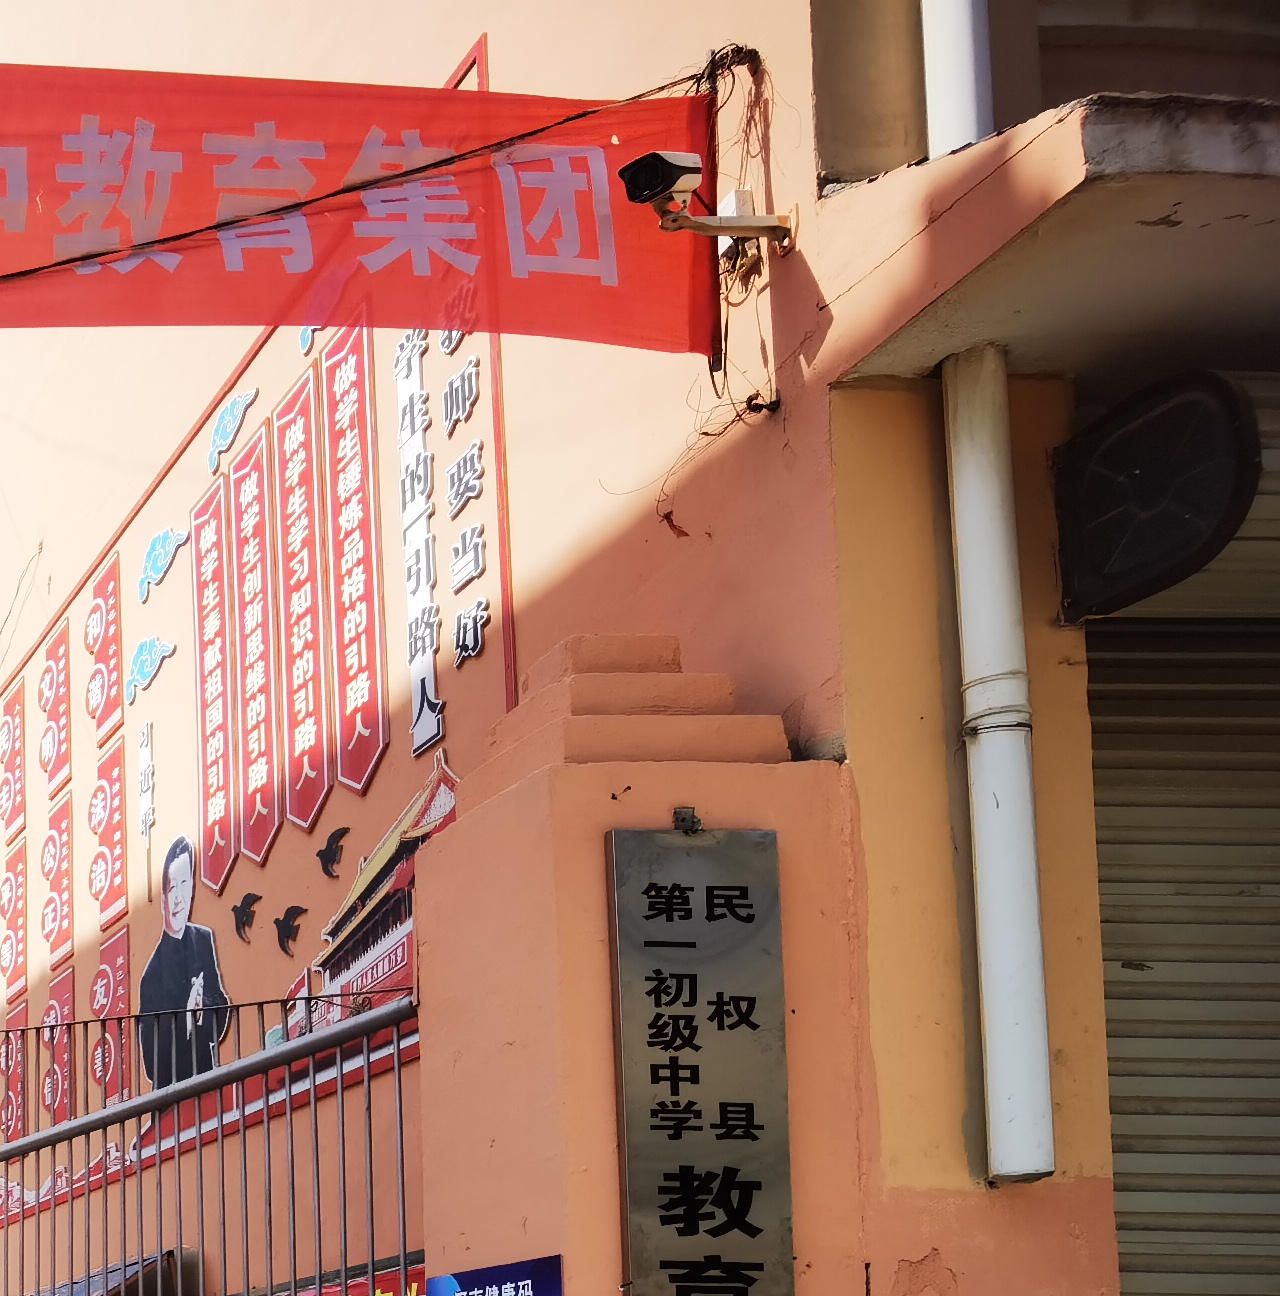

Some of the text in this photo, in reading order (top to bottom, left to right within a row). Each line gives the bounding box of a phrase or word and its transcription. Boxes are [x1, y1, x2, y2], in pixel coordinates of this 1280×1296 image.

[198, 514, 227, 857] 做学生奉献祖国的引路人
[239, 469, 269, 827] 做学生创新思维的引路人
[282, 415, 317, 791] 做学生学习知识的引路人
[332, 351, 371, 751] 做学生锤炼品格的引路人
[393, 329, 443, 755] 学生的引路人
[641, 882, 703, 1141] 第一初级中学
[704, 885, 766, 1142] 民权县
